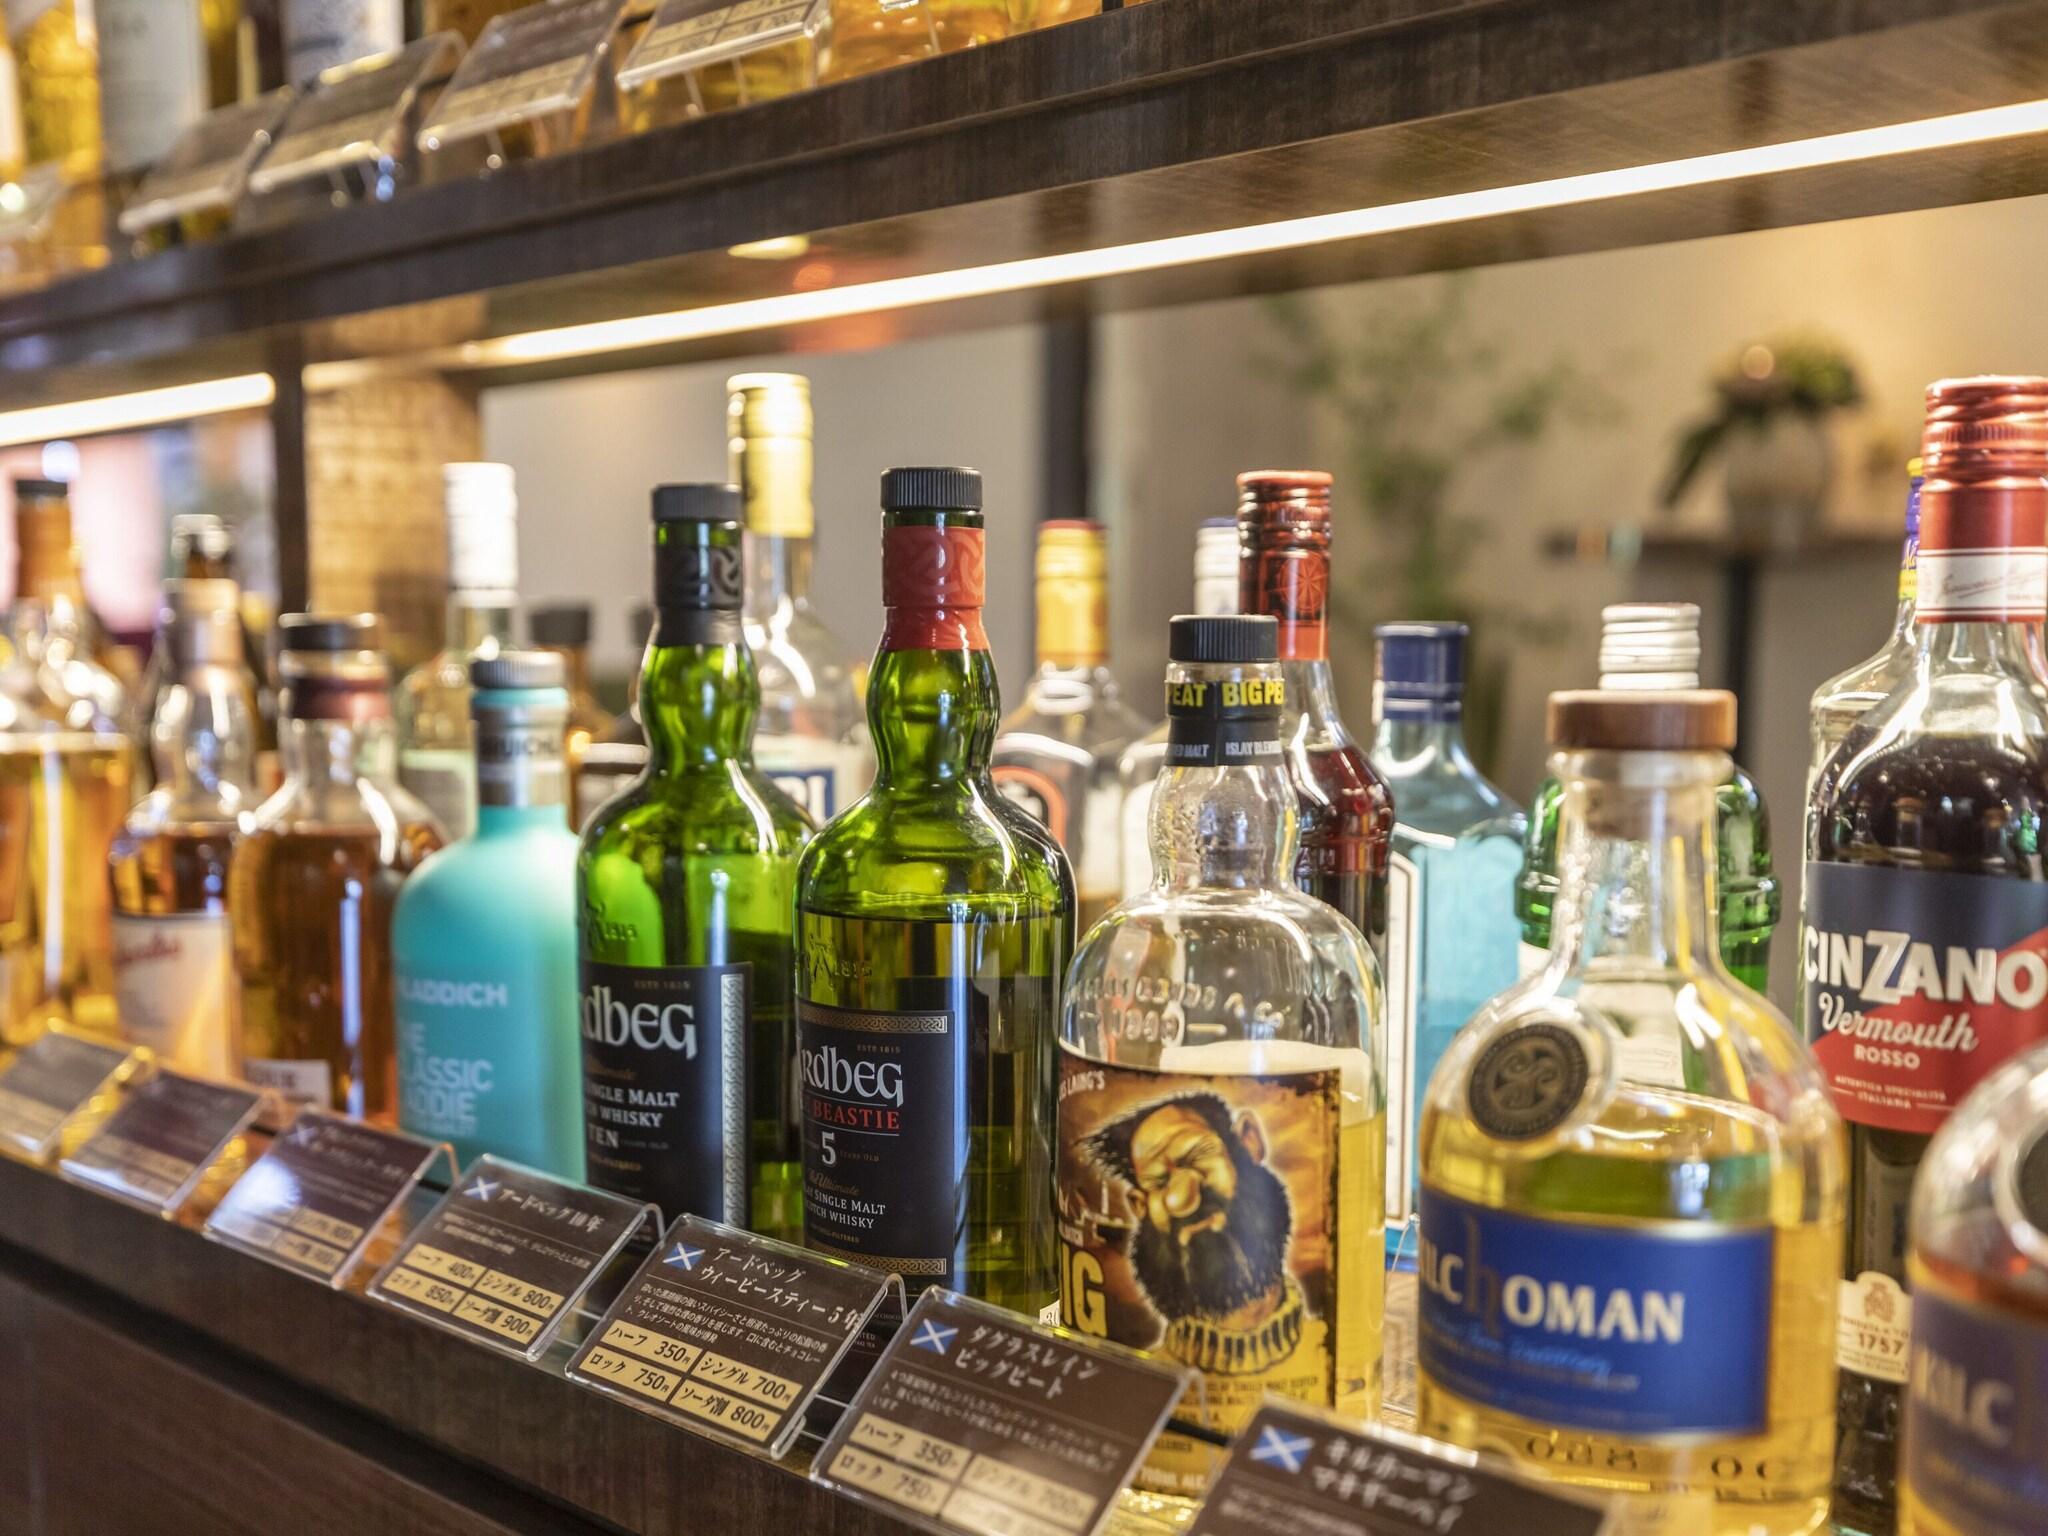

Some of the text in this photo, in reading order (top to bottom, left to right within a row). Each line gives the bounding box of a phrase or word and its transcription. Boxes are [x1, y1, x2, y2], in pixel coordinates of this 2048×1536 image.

[1225, 741, 1252, 756] ISLAY
[1804, 925, 2048, 1010] CINZANO
[1819, 992, 1979, 1054] Vermouth
[1854, 1043, 1921, 1071] ROSSO
[628, 1088, 681, 1109] MALT
[601, 1109, 664, 1129] WHISKY
[813, 1098, 901, 1131] BEASTIE
[588, 1122, 620, 1150] TEN
[820, 1131, 838, 1166] 5
[815, 1189, 848, 1210] SINGLE
[851, 1200, 886, 1216] MALT
[829, 1211, 875, 1229] WHISKY
[415, 1251, 442, 1265] ハーフ
[713, 1247, 807, 1284] アードベッグ
[481, 1274, 555, 1311] シングル 800円
[501, 1315, 533, 1336] 900円
[609, 1326, 690, 1364] ハーフ 350円
[968, 1325, 1101, 1380] ダグラスレイン
[1858, 1331, 1905, 1356] 1757
[588, 1353, 669, 1392] ロック 750円
[700, 1357, 791, 1403] シングル 700円
[678, 1386, 770, 1431] ソーダ割 800円
[860, 1423, 905, 1447] ハーフ
[840, 1455, 884, 1480] ロック
